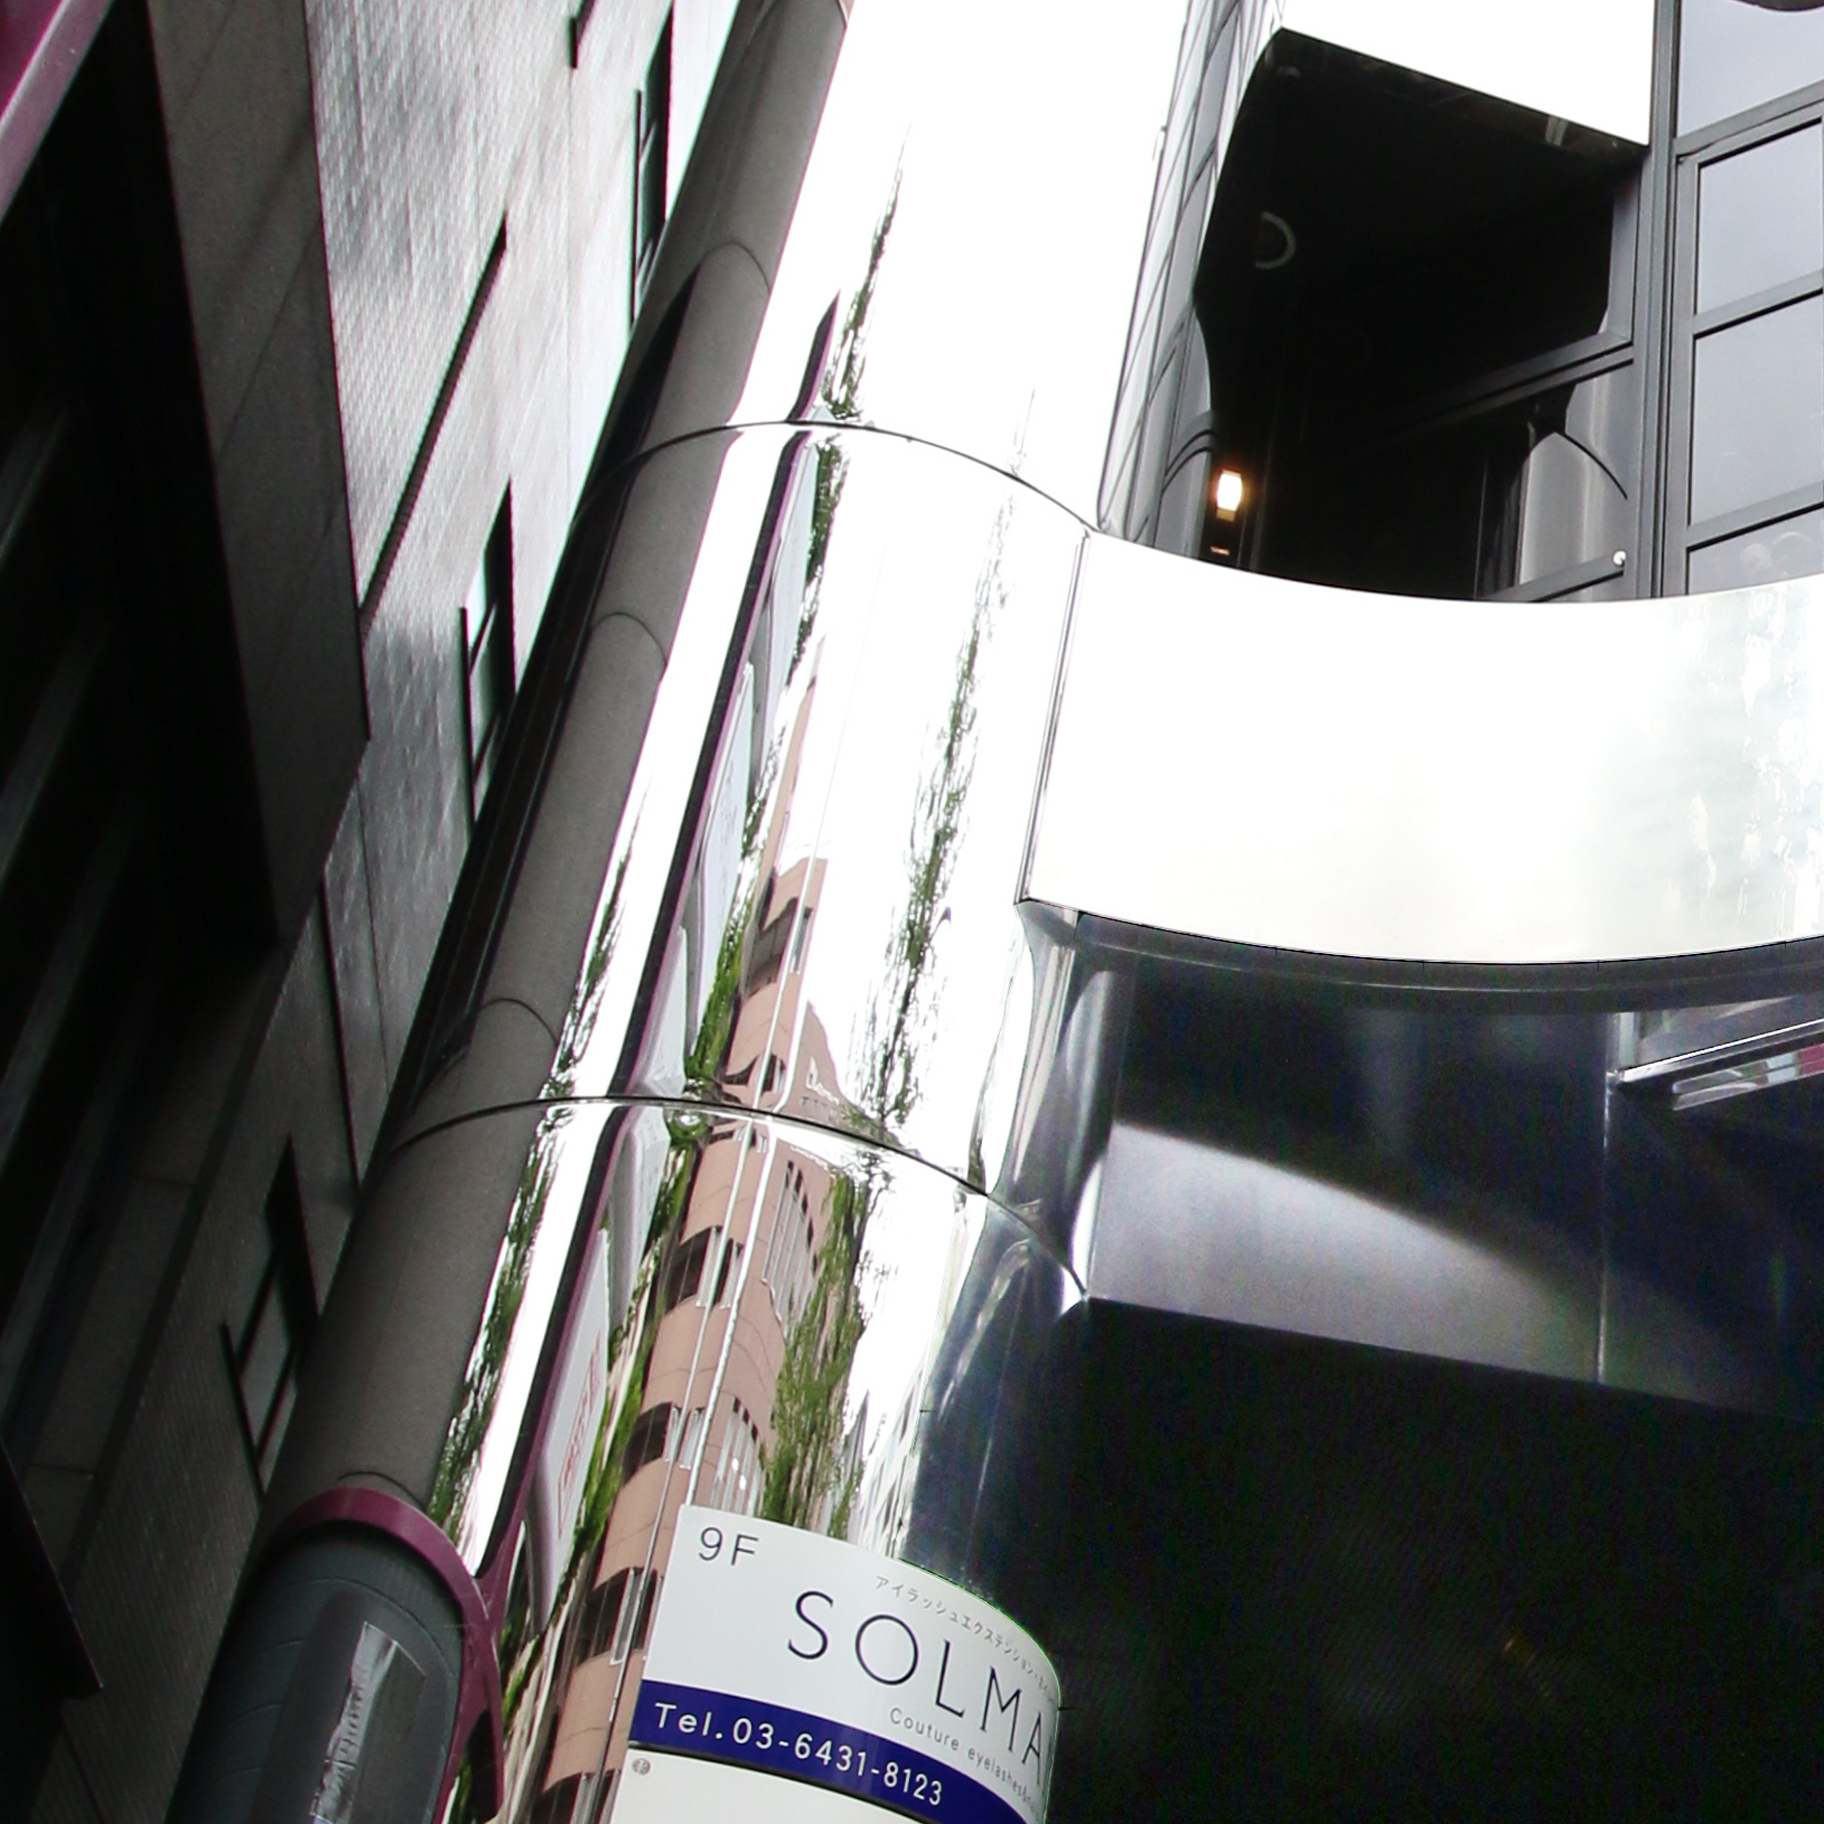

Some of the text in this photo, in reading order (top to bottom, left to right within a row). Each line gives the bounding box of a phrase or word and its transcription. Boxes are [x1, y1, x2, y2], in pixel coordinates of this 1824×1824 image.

[698, 1526, 759, 1567] 9F
[788, 1590, 1046, 1787] SOLMA
[654, 1701, 943, 1807] Tel.03-6431-8123
[889, 1707, 960, 1752] Couture
